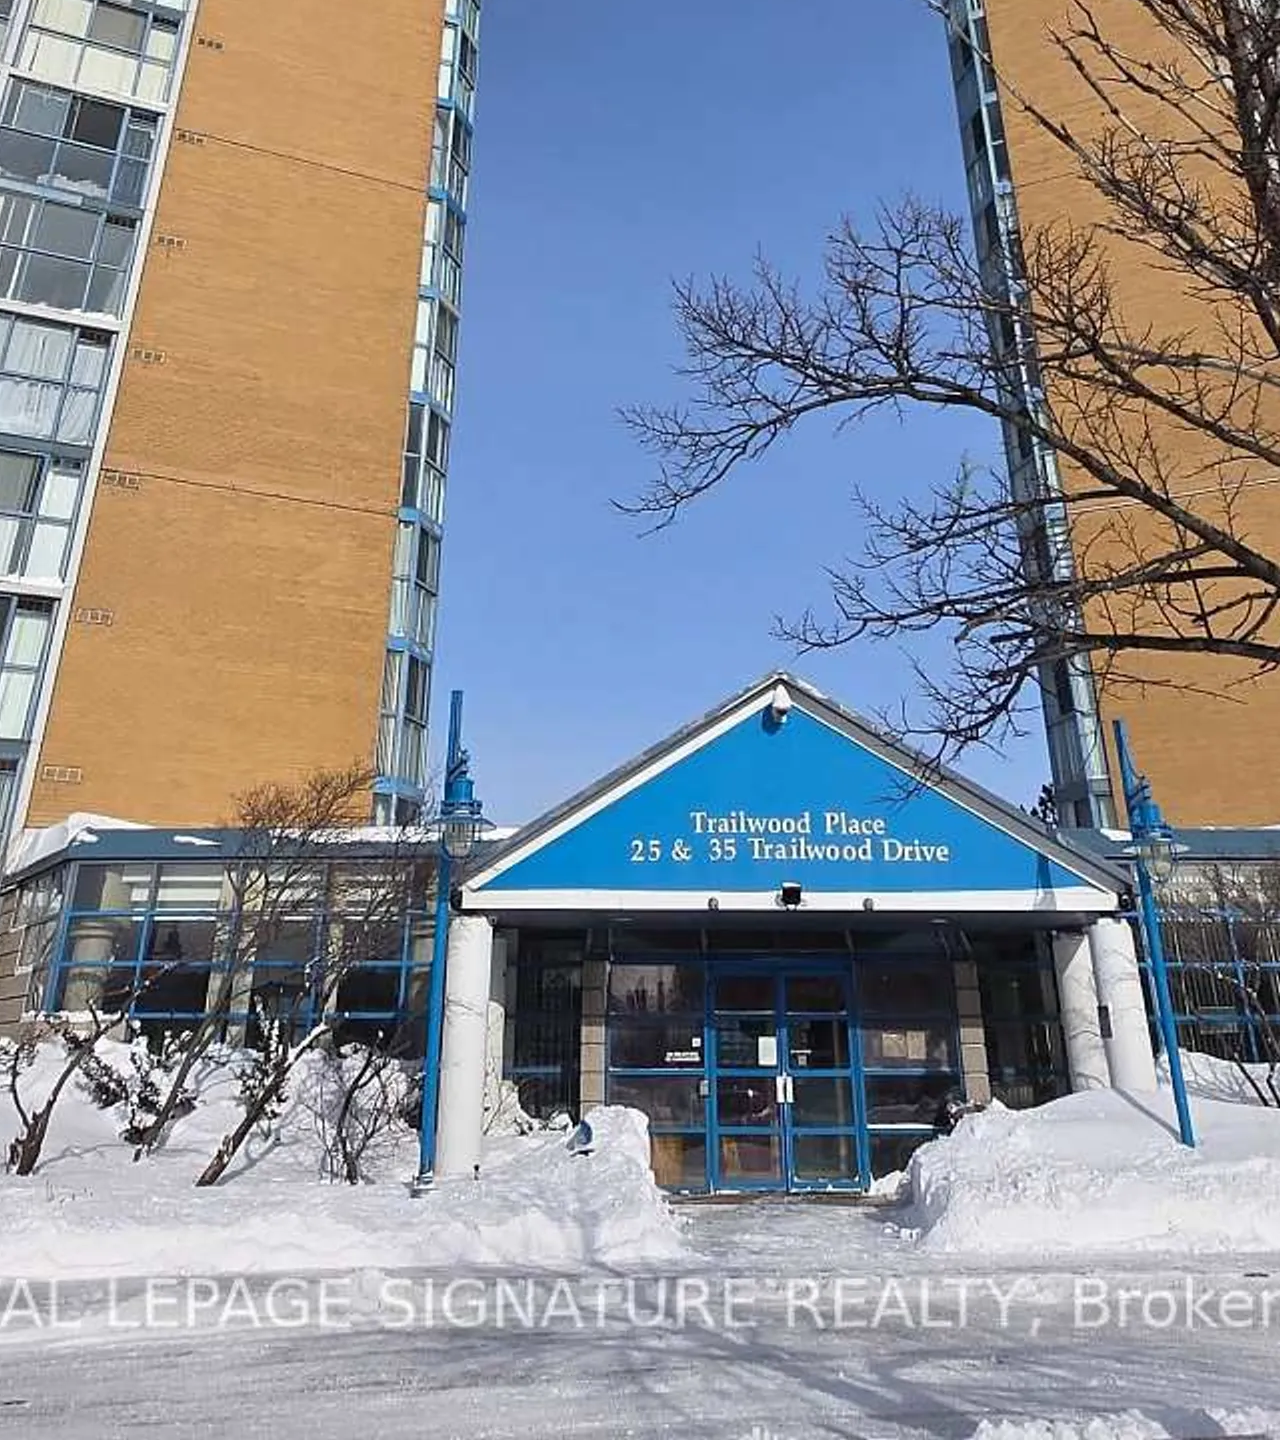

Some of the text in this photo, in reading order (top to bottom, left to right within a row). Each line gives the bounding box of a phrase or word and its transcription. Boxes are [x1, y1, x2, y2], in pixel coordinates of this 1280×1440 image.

[689, 810, 886, 835] Trailwood Place
[630, 837, 950, 862] 25 & 35 Trailwood Drive
